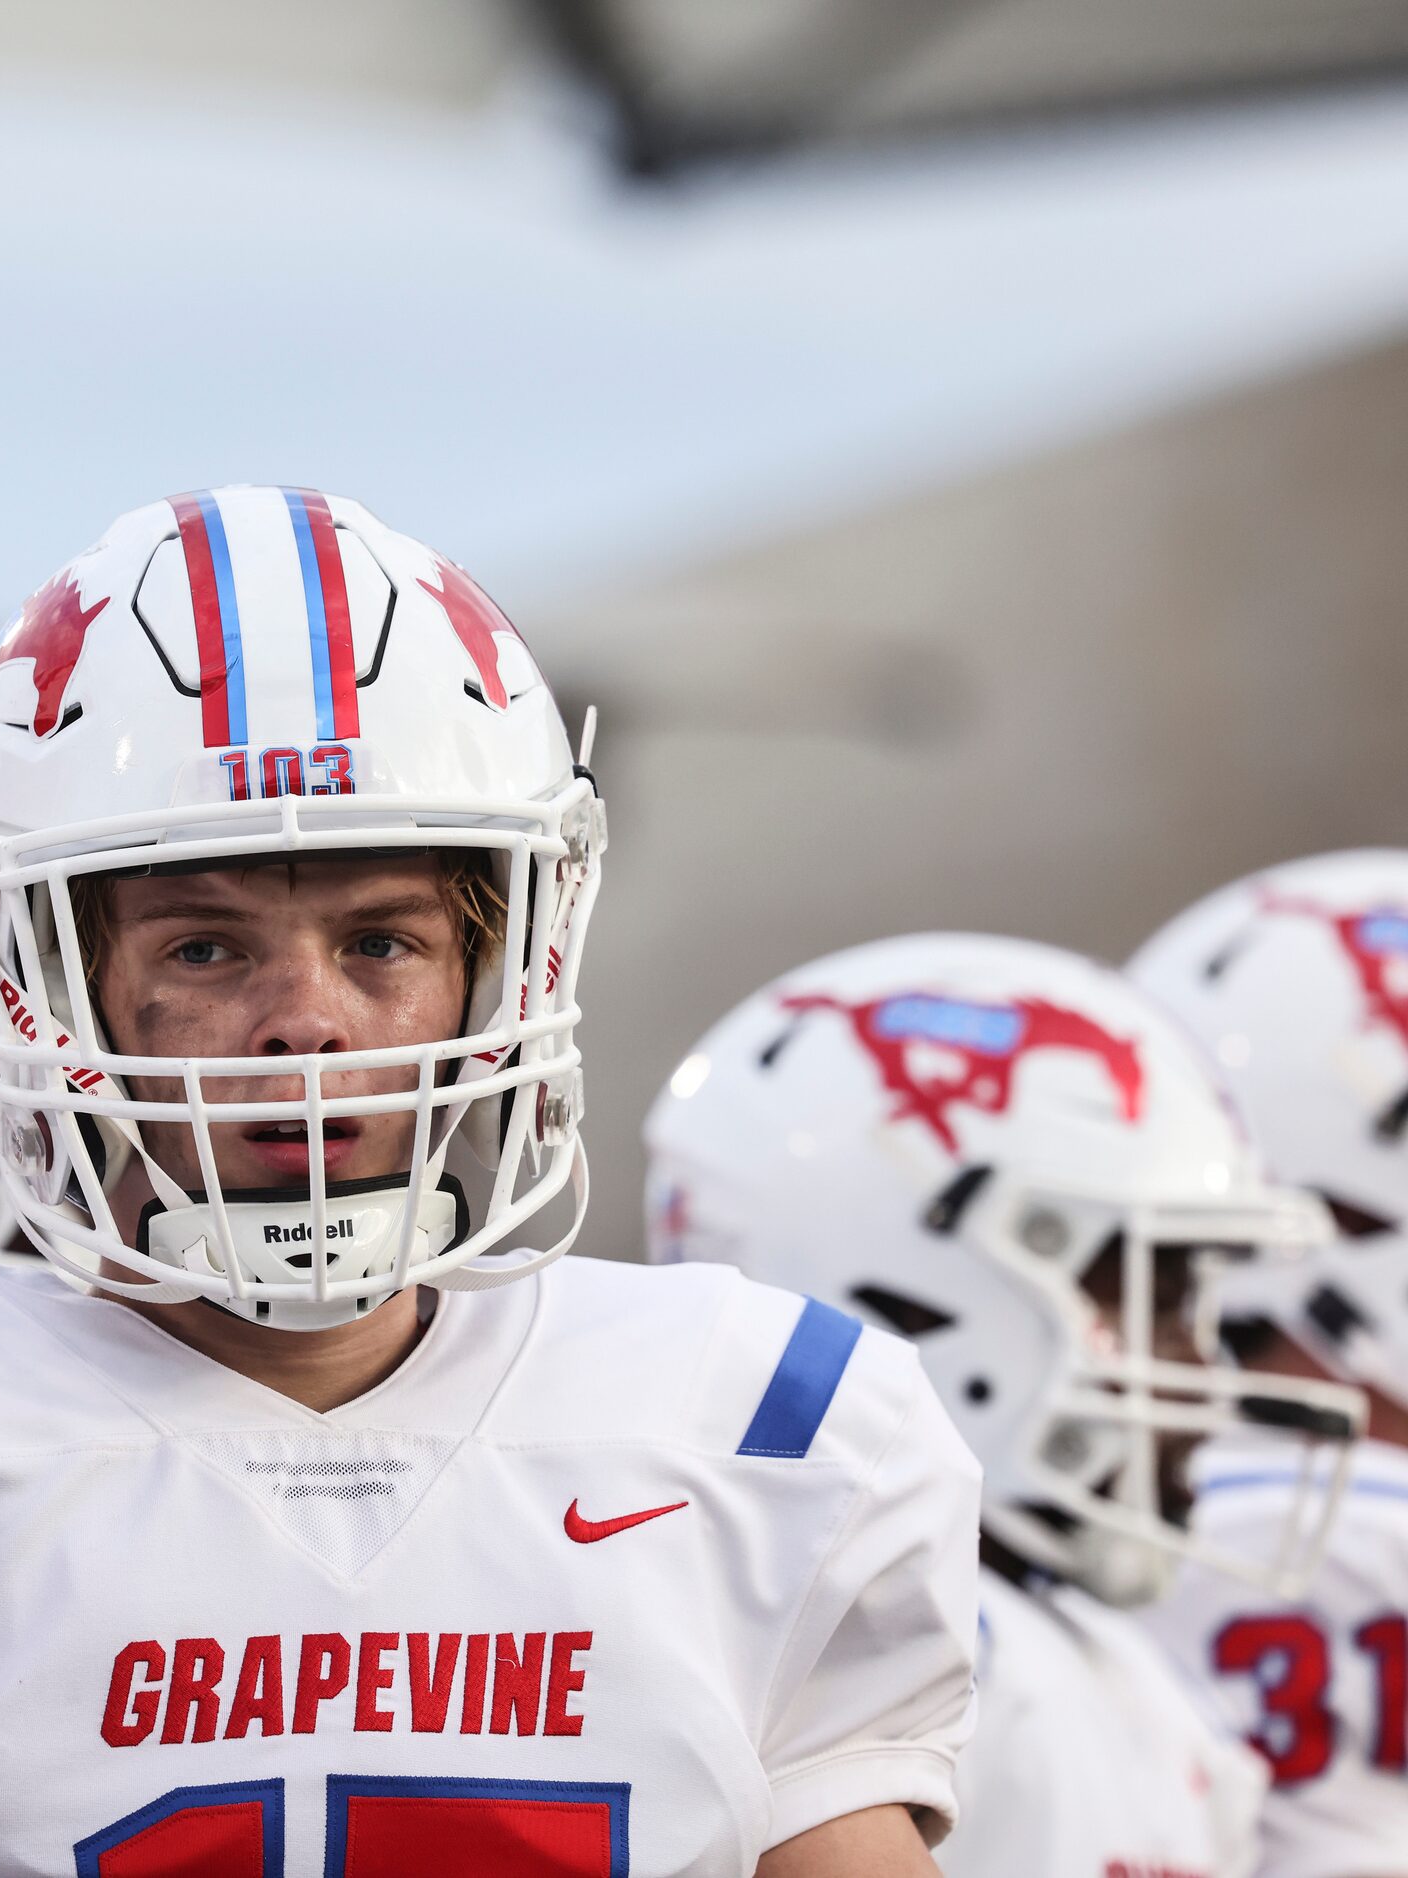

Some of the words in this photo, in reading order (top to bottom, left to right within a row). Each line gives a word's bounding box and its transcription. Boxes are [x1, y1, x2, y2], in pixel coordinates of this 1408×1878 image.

[218, 744, 356, 801] 103
[0, 979, 105, 1089] Ridll
[100, 1631, 593, 1748] GRAPEVINE
[1210, 1609, 1408, 1788] 31
